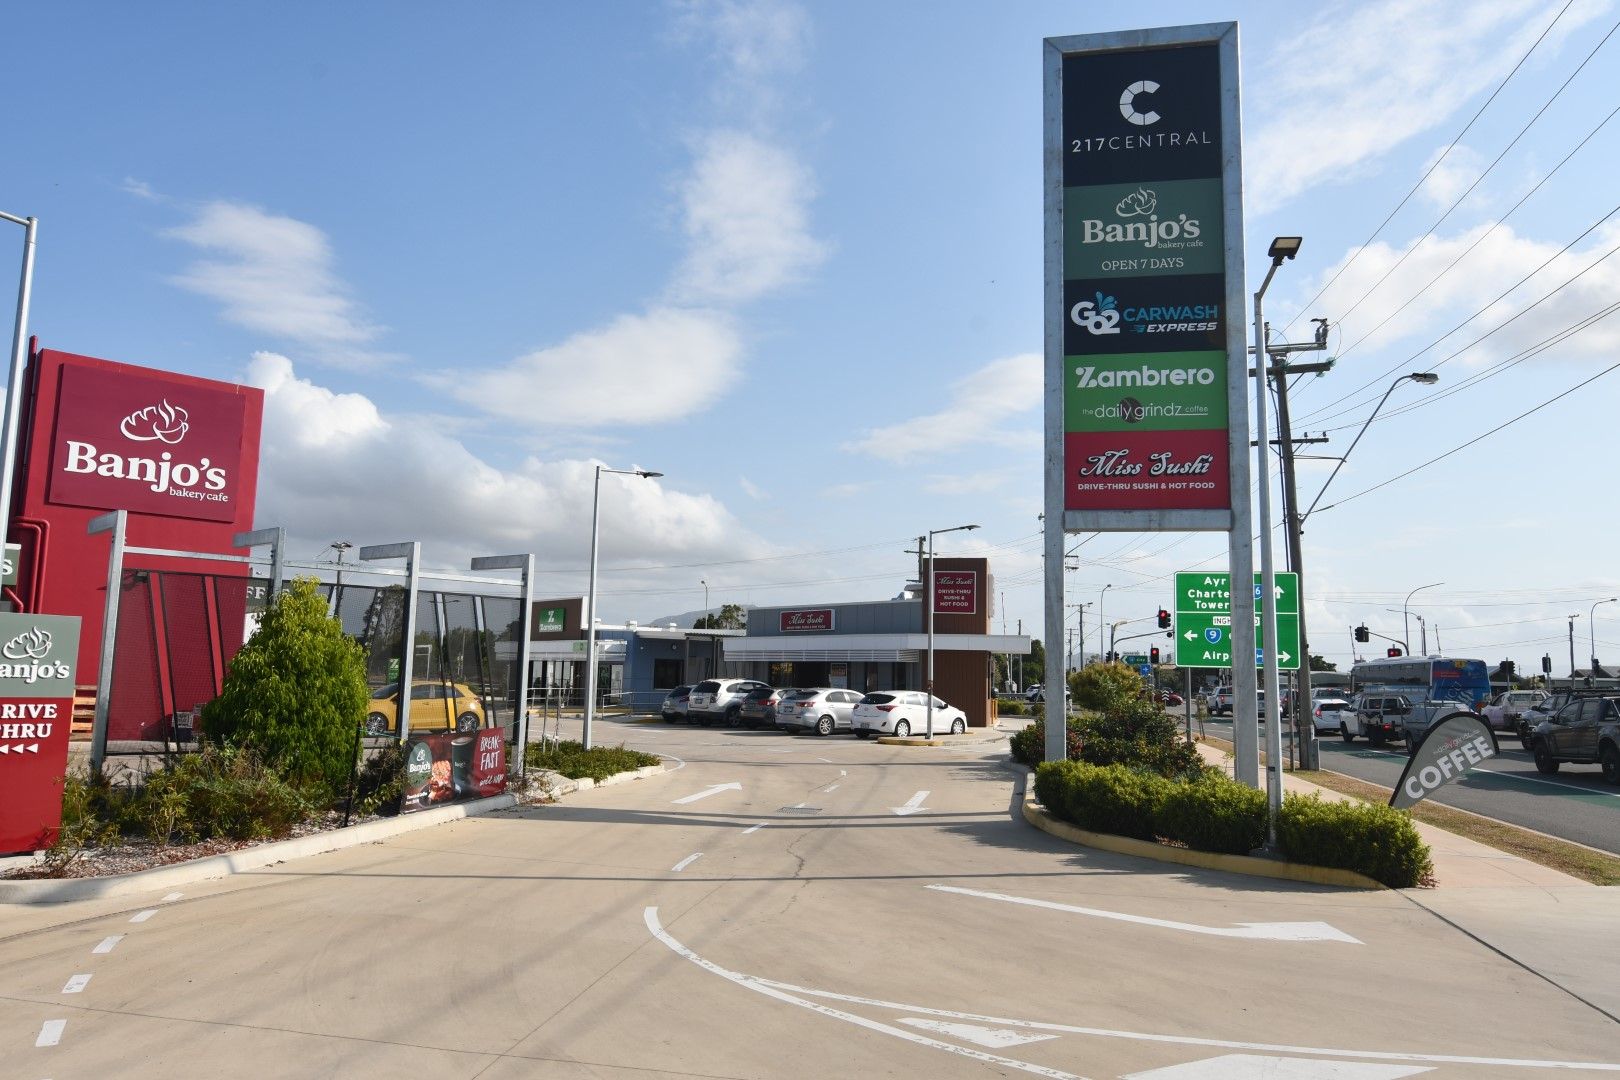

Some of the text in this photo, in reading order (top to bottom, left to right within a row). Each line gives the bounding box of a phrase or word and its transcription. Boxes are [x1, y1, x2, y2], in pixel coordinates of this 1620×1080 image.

[1071, 131, 1211, 152] 217CENTRAL
[1082, 213, 1200, 248] Banjo's
[1157, 240, 1204, 249] bakery cafe
[1102, 257, 1184, 271] OPEN 7 DAYS
[1123, 305, 1219, 322] CARWASH
[1147, 322, 1218, 333] EXPRESS
[1075, 365, 1215, 388] Zambrero
[1184, 405, 1209, 414] coffee
[63, 440, 226, 493] Banjo's
[1080, 449, 1214, 478] Miss Sushi
[1077, 481, 1216, 491] DRIVE-THRU SUSHI & HOT FOOD
[169, 486, 228, 503] bakery cafe
[1204, 577, 1226, 587] Ayr
[1188, 589, 1230, 599] Charte
[1195, 600, 1230, 609] Tower
[1209, 630, 1217, 639] 9
[1203, 651, 1230, 661] Airp
[0, 659, 70, 683] anjo's
[0, 703, 58, 719] RIVE
[0, 723, 52, 738] HRU
[480, 750, 500, 770] FAST
[1405, 736, 1494, 799] COFFEE
